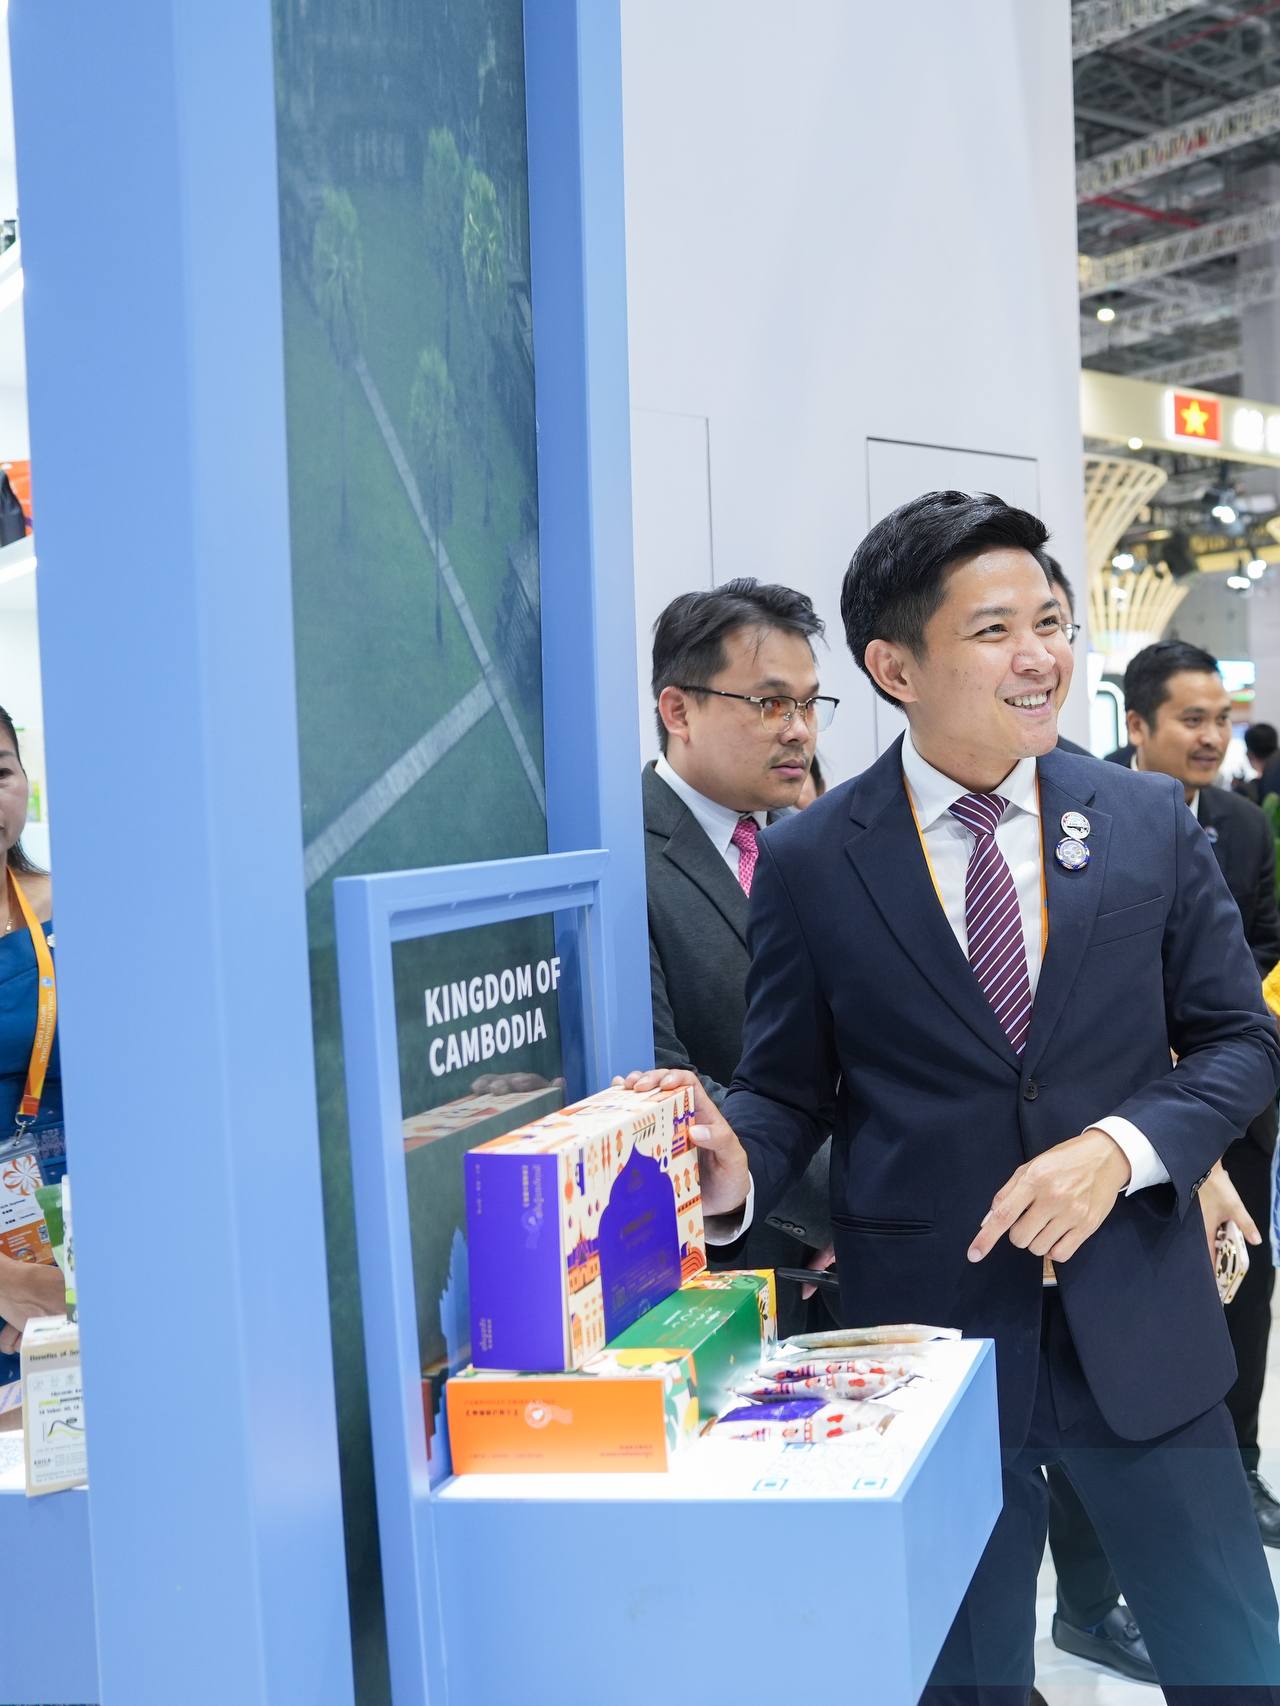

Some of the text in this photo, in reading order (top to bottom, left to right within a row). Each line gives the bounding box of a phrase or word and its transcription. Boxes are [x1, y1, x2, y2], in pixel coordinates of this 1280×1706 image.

[425, 957, 561, 1027] KINGDOM OF
[429, 1007, 548, 1077] CAMBODIA
